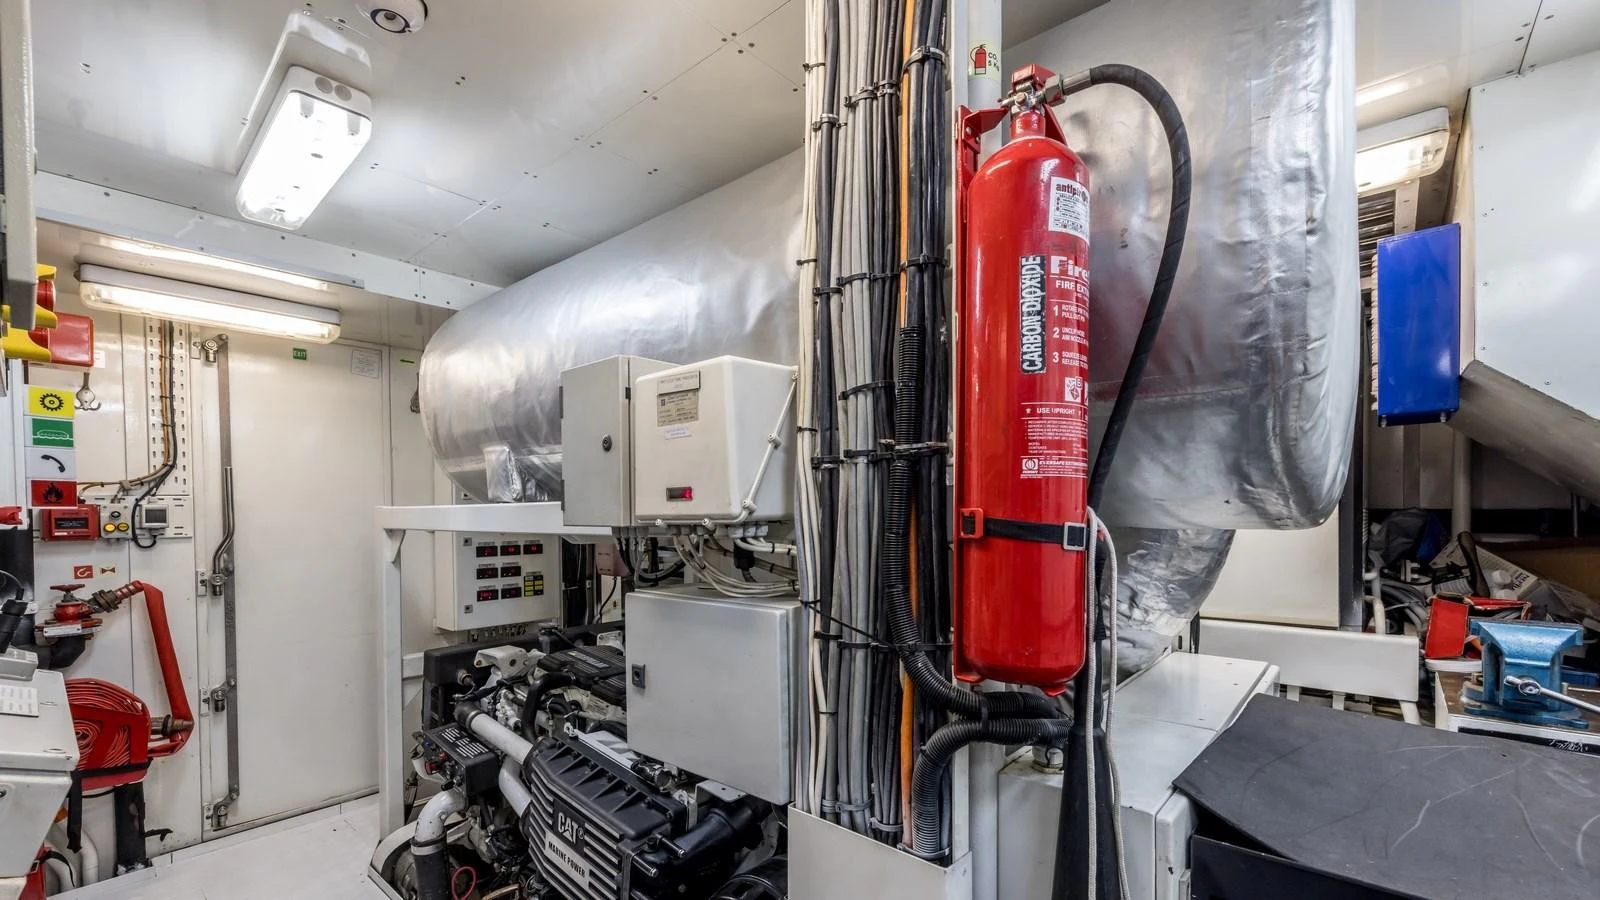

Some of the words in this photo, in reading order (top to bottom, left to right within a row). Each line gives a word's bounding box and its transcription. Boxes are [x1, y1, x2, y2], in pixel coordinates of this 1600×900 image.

[1050, 255, 1089, 281] Fire
[1021, 255, 1043, 311] DIOXIDE
[1056, 280, 1075, 291] FIRE
[1053, 304, 1059, 316] 1
[1052, 327, 1060, 338] 2
[1021, 317, 1043, 371] CARBON
[1052, 352, 1059, 363] 3
[548, 841, 567, 862] MARINE
[567, 856, 586, 878] POWER
